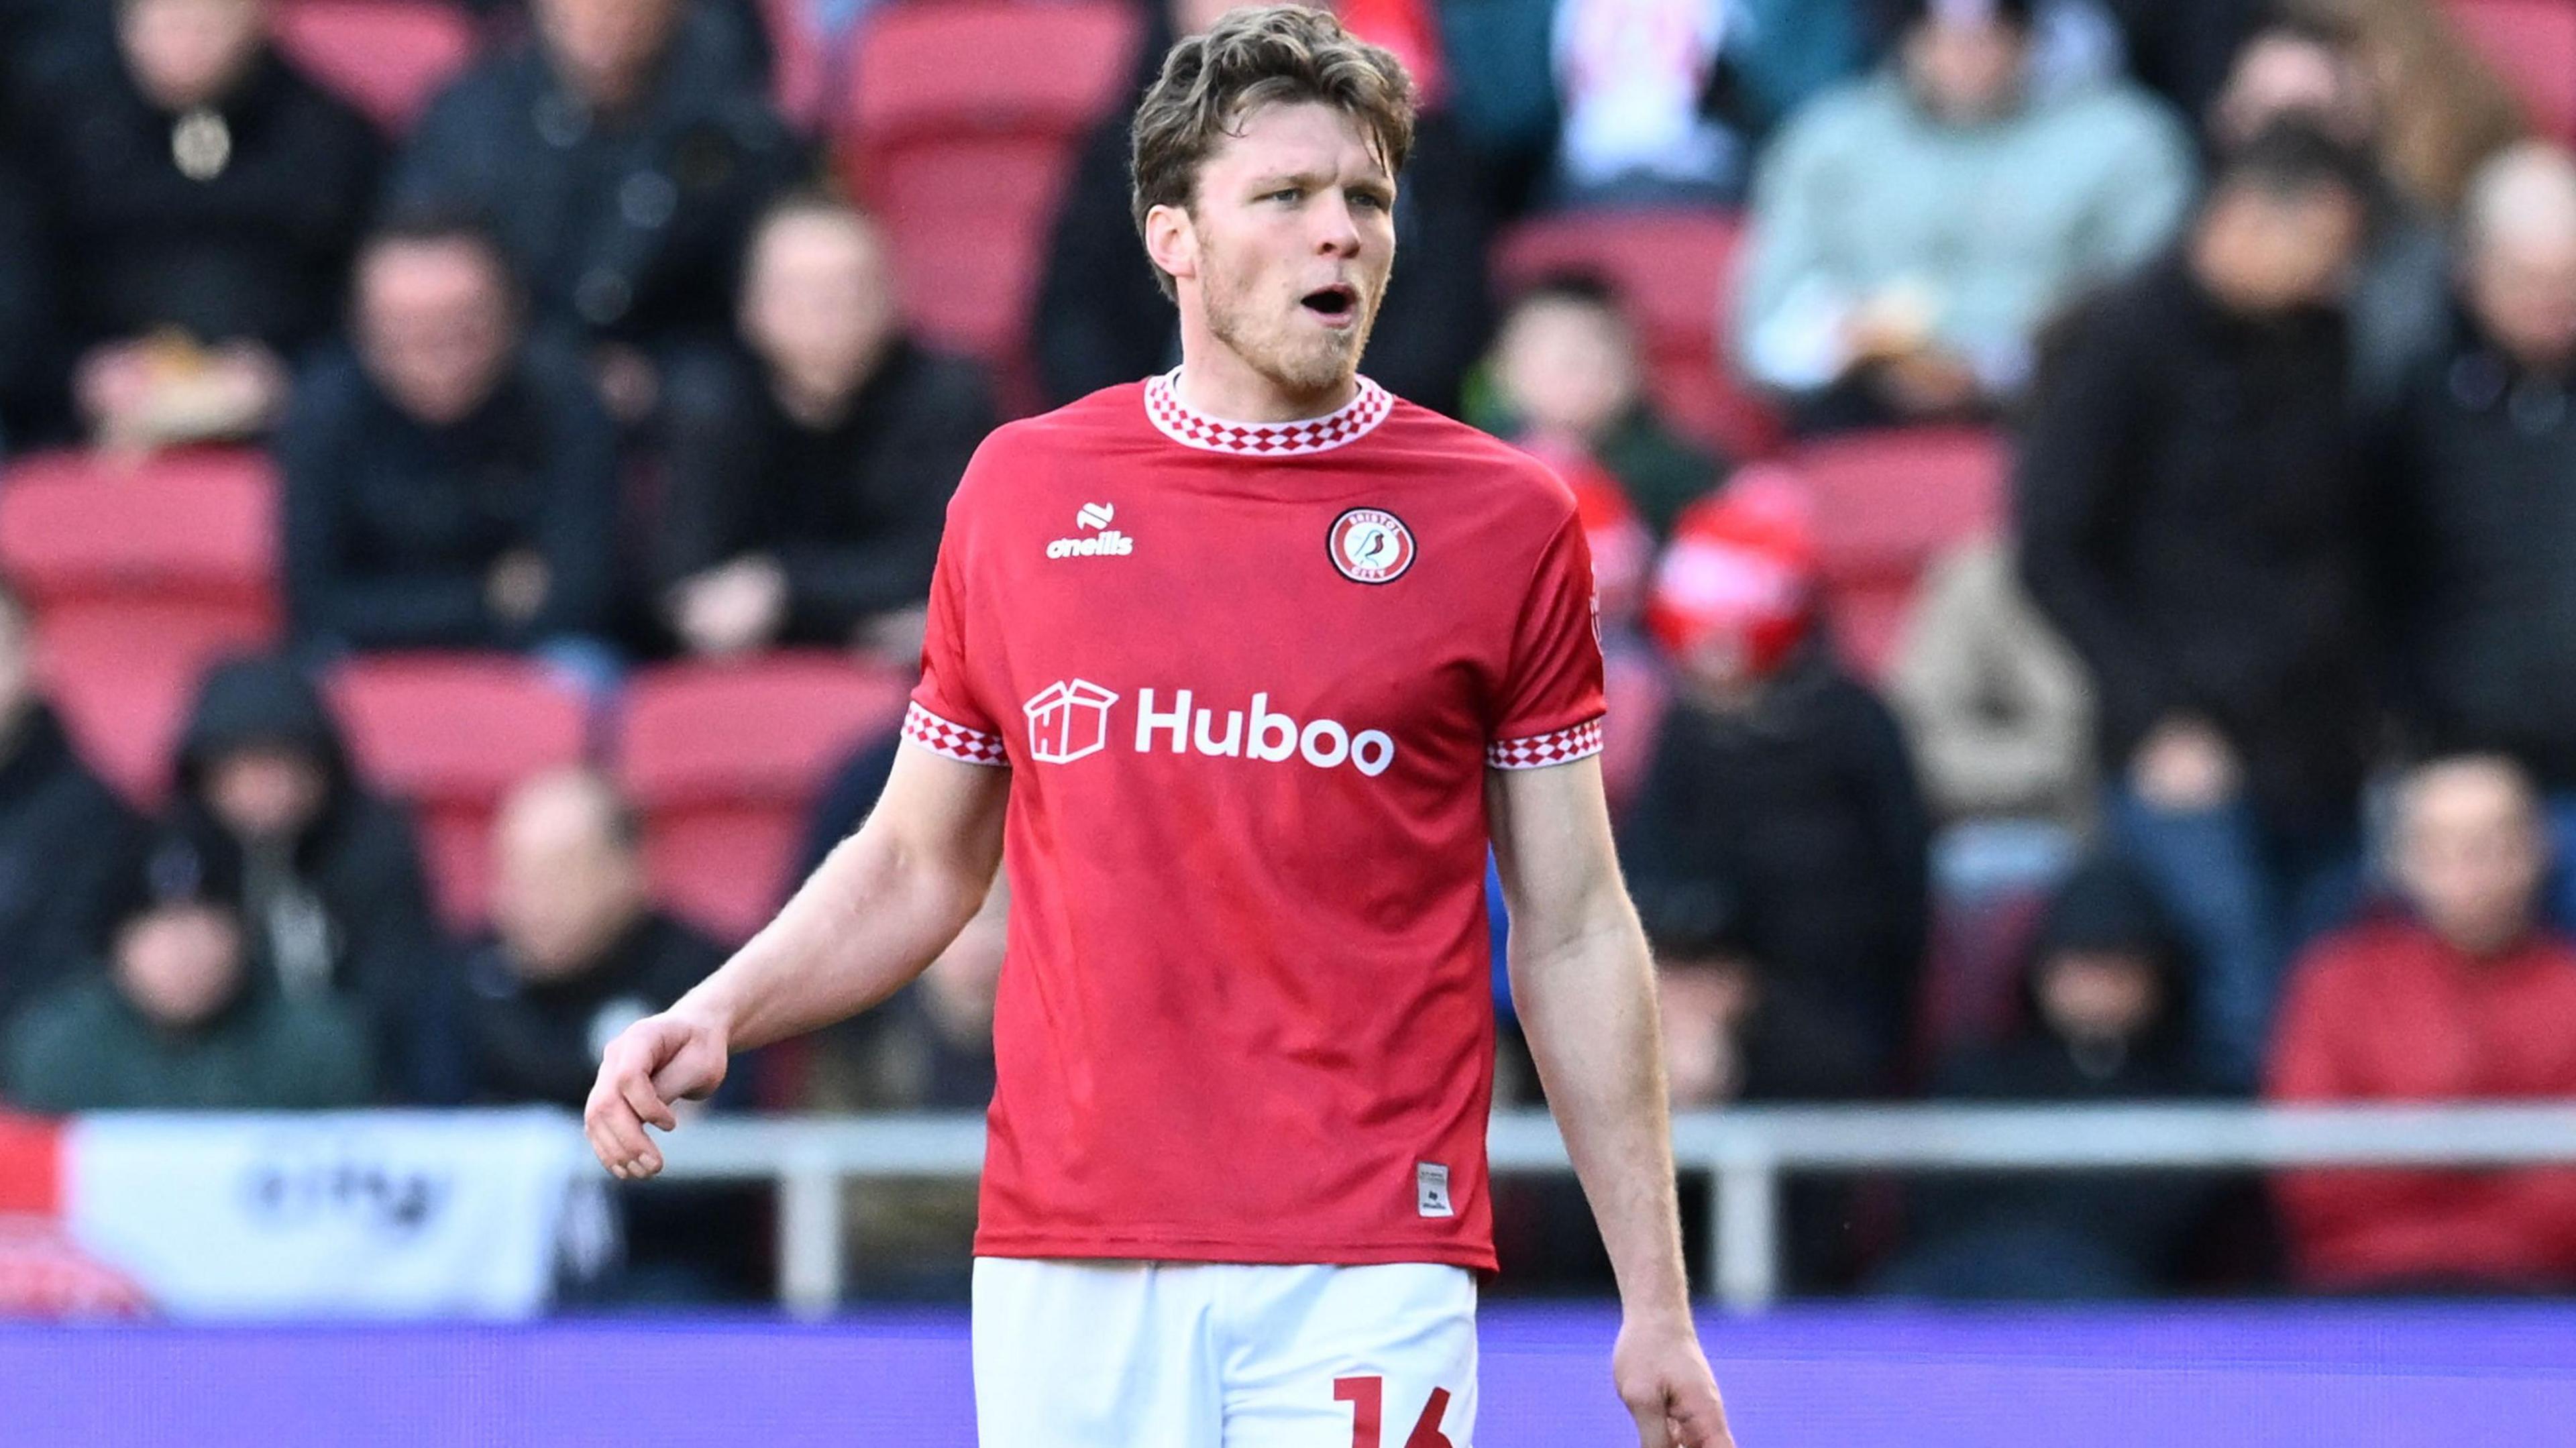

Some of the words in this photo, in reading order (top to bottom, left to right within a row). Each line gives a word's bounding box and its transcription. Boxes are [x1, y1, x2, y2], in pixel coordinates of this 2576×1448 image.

[1348, 512, 1401, 537] BRISTOL
[1351, 565, 1387, 579] CITY
[1135, 688, 1395, 777] Huboo
